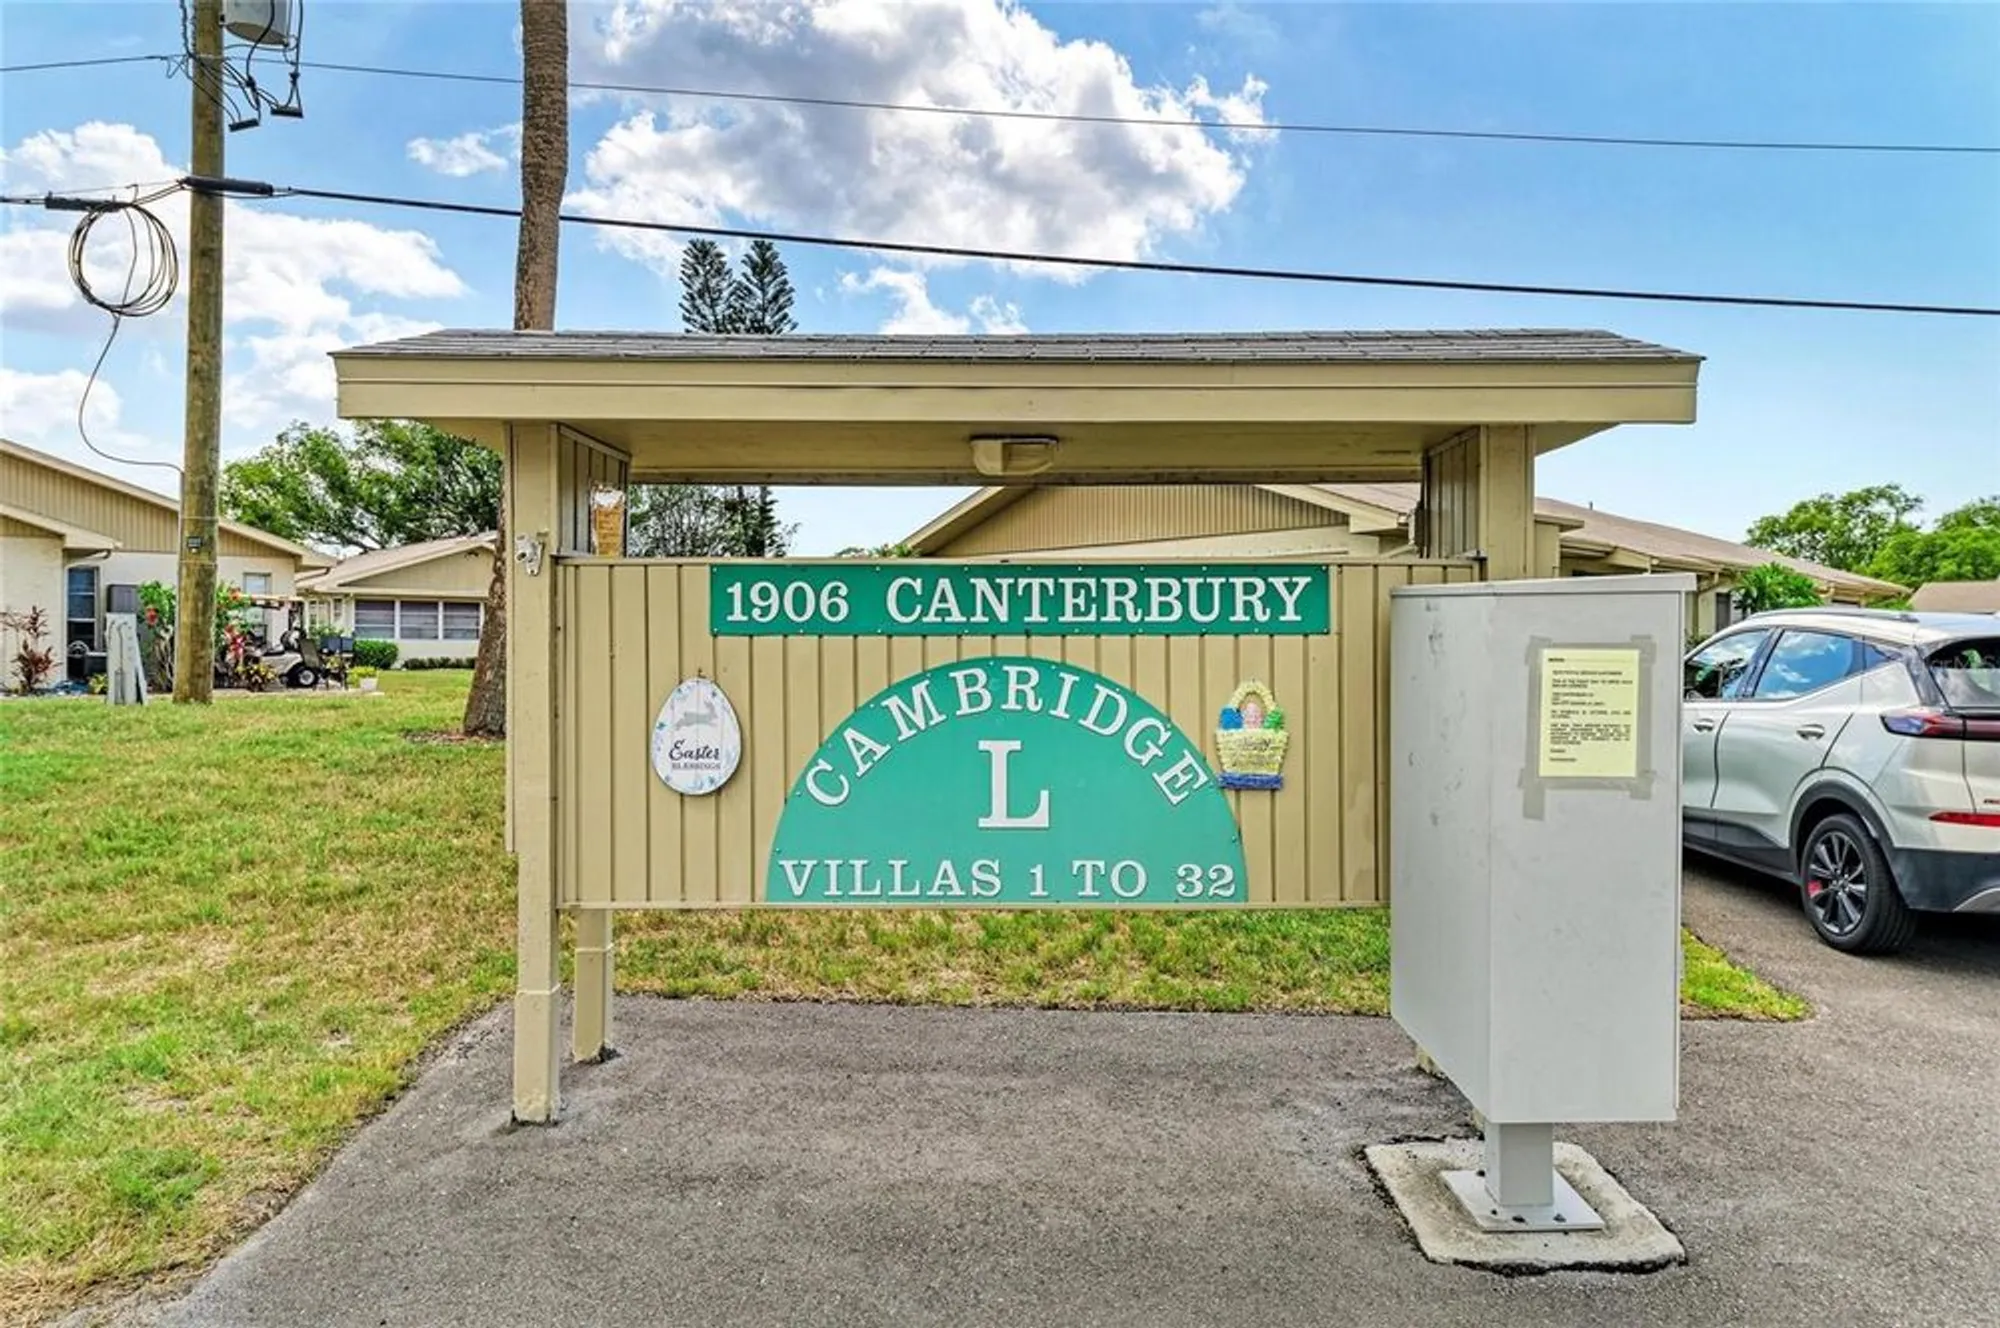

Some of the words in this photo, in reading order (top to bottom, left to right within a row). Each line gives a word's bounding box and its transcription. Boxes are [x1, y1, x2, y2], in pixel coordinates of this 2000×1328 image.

[726, 579, 850, 623] 1906
[886, 576, 1312, 623] CANTERBURY
[669, 739, 720, 761] Easter
[803, 663, 1208, 806] CAMBRIDGE
[977, 739, 1050, 830] L
[780, 859, 1001, 897] VILLAS
[1029, 864, 1048, 897] 1
[1072, 860, 1148, 897] TO
[1176, 863, 1235, 897] 32
